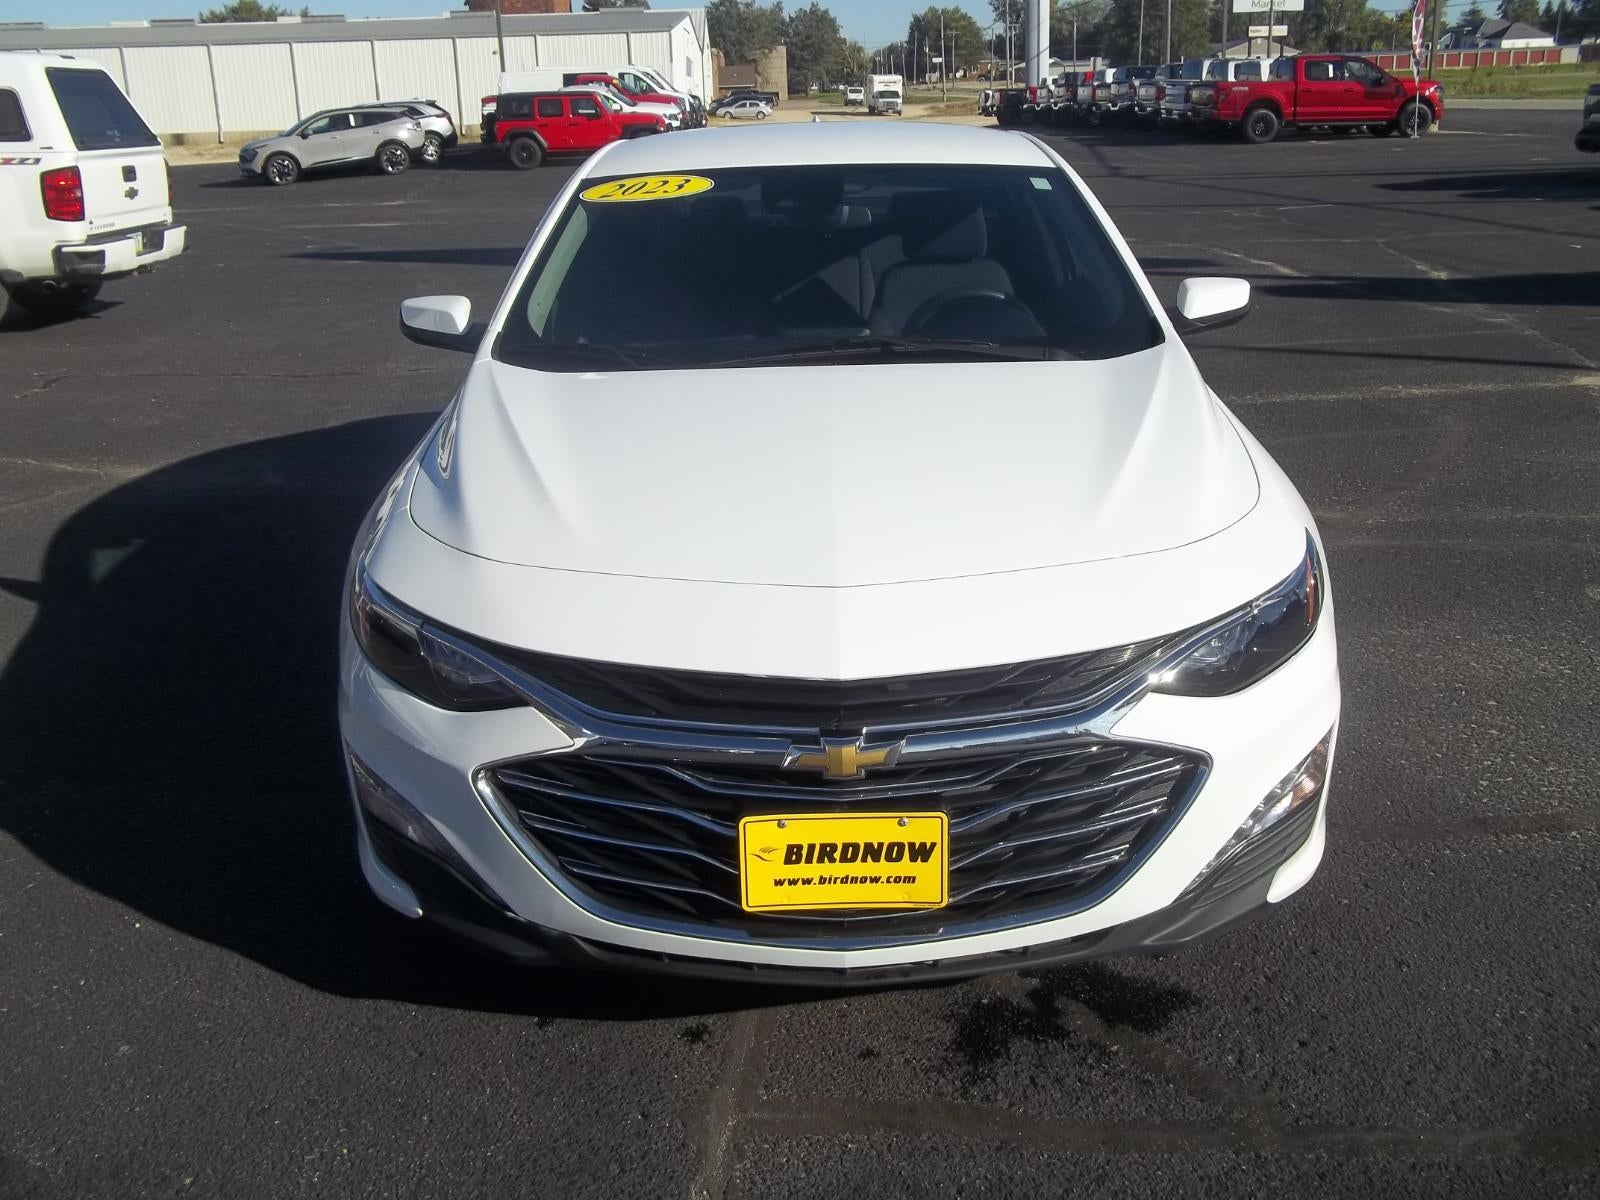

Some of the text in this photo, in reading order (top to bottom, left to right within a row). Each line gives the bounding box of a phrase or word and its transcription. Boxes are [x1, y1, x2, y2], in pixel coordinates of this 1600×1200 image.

[598, 179, 692, 198] 2023
[784, 842, 937, 865] BIRDNOW
[773, 875, 917, 887] www.birdnow.com
